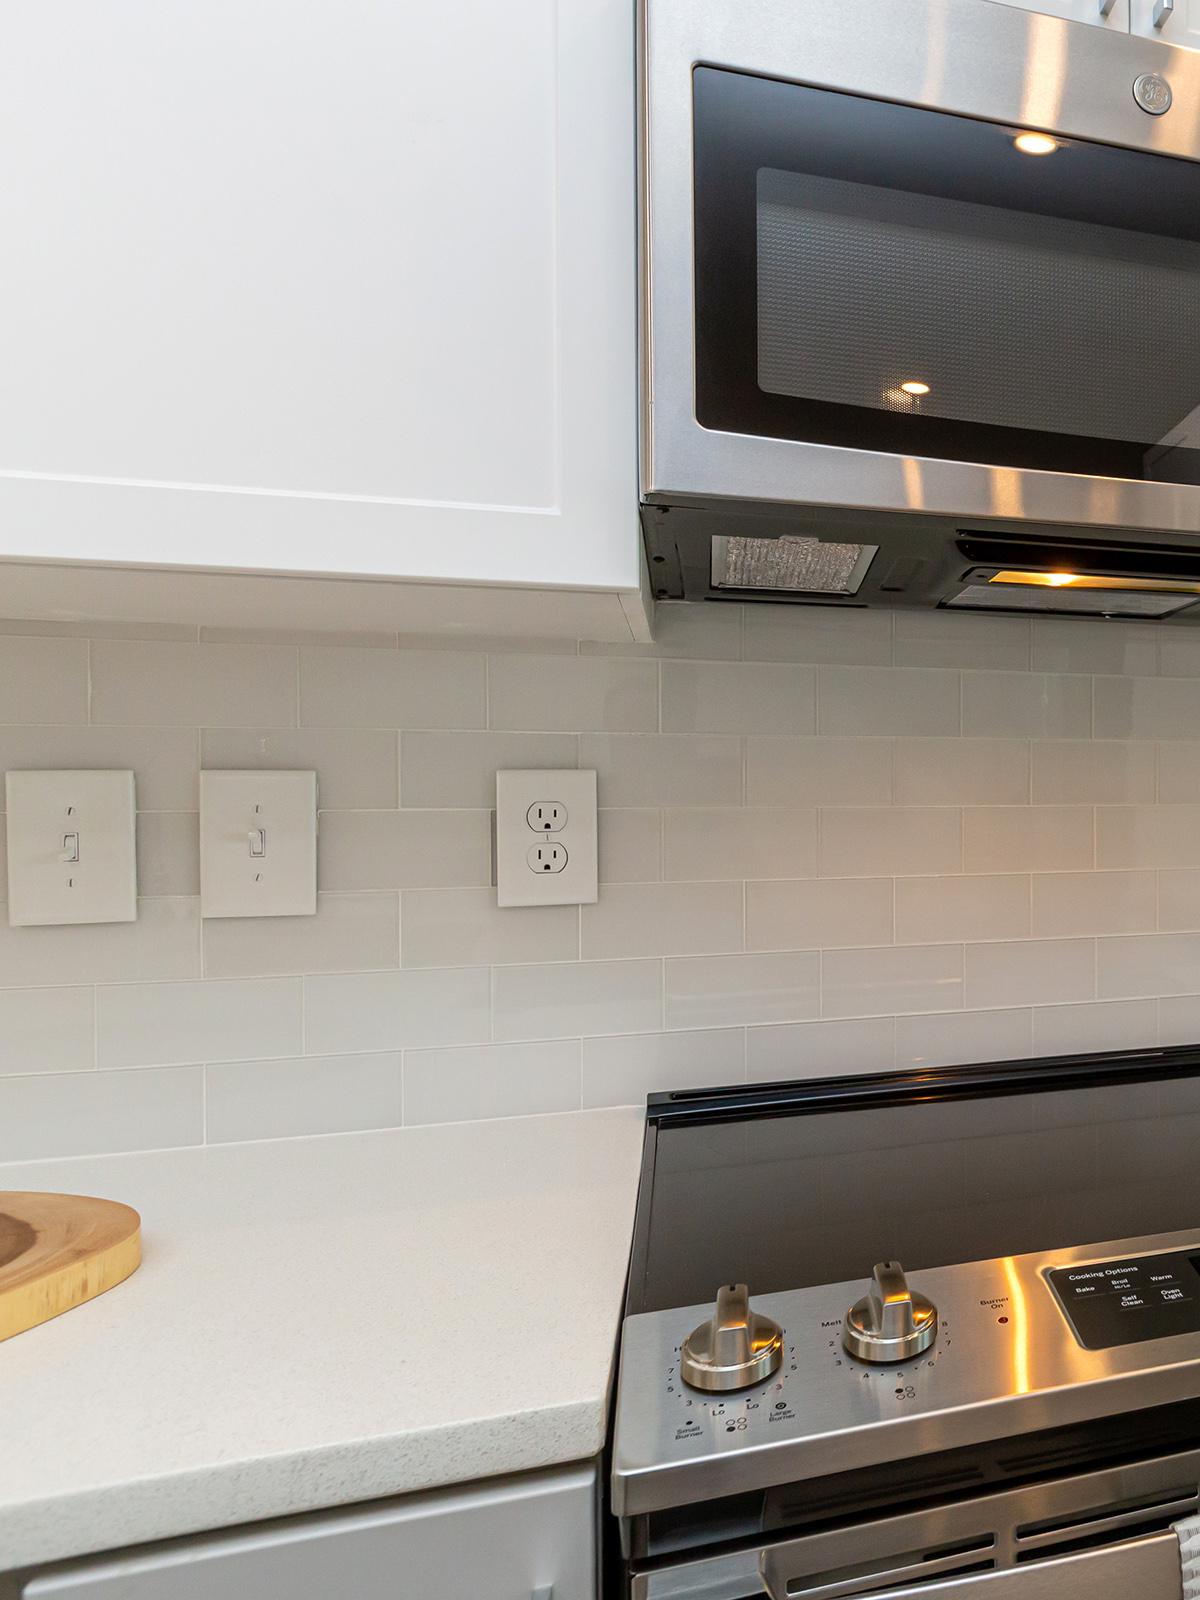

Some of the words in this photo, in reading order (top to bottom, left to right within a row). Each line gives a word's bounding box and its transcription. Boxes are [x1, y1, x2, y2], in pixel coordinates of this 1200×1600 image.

[1069, 1270, 1105, 1281] Cooking
[1105, 1266, 1139, 1275] Options
[1160, 1288, 1181, 1296] Oven
[1163, 1292, 1183, 1300] Light
[980, 1297, 1008, 1305] Burner
[1121, 1299, 1143, 1307] Clean
[821, 1320, 841, 1328] Melt
[770, 1409, 792, 1417] Large
[769, 1414, 796, 1422] Burner
[677, 1426, 701, 1434] Small
[675, 1431, 704, 1440] Burner
